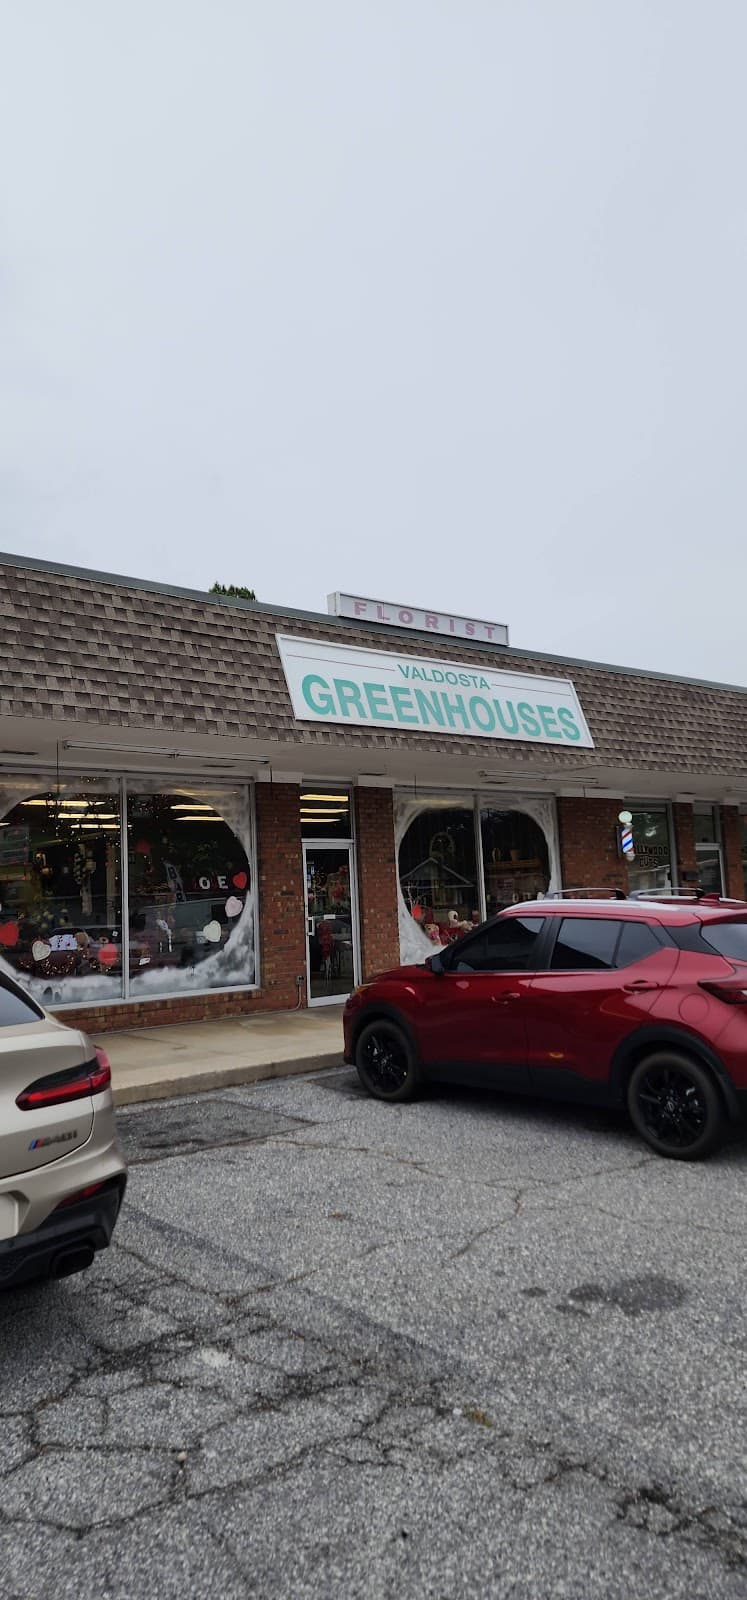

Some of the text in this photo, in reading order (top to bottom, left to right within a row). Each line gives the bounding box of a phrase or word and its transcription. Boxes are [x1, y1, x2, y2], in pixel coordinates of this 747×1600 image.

[353, 601, 496, 640] FLORIST
[396, 663, 491, 690] VALDOSTA
[301, 674, 581, 741] GREENHOUSES
